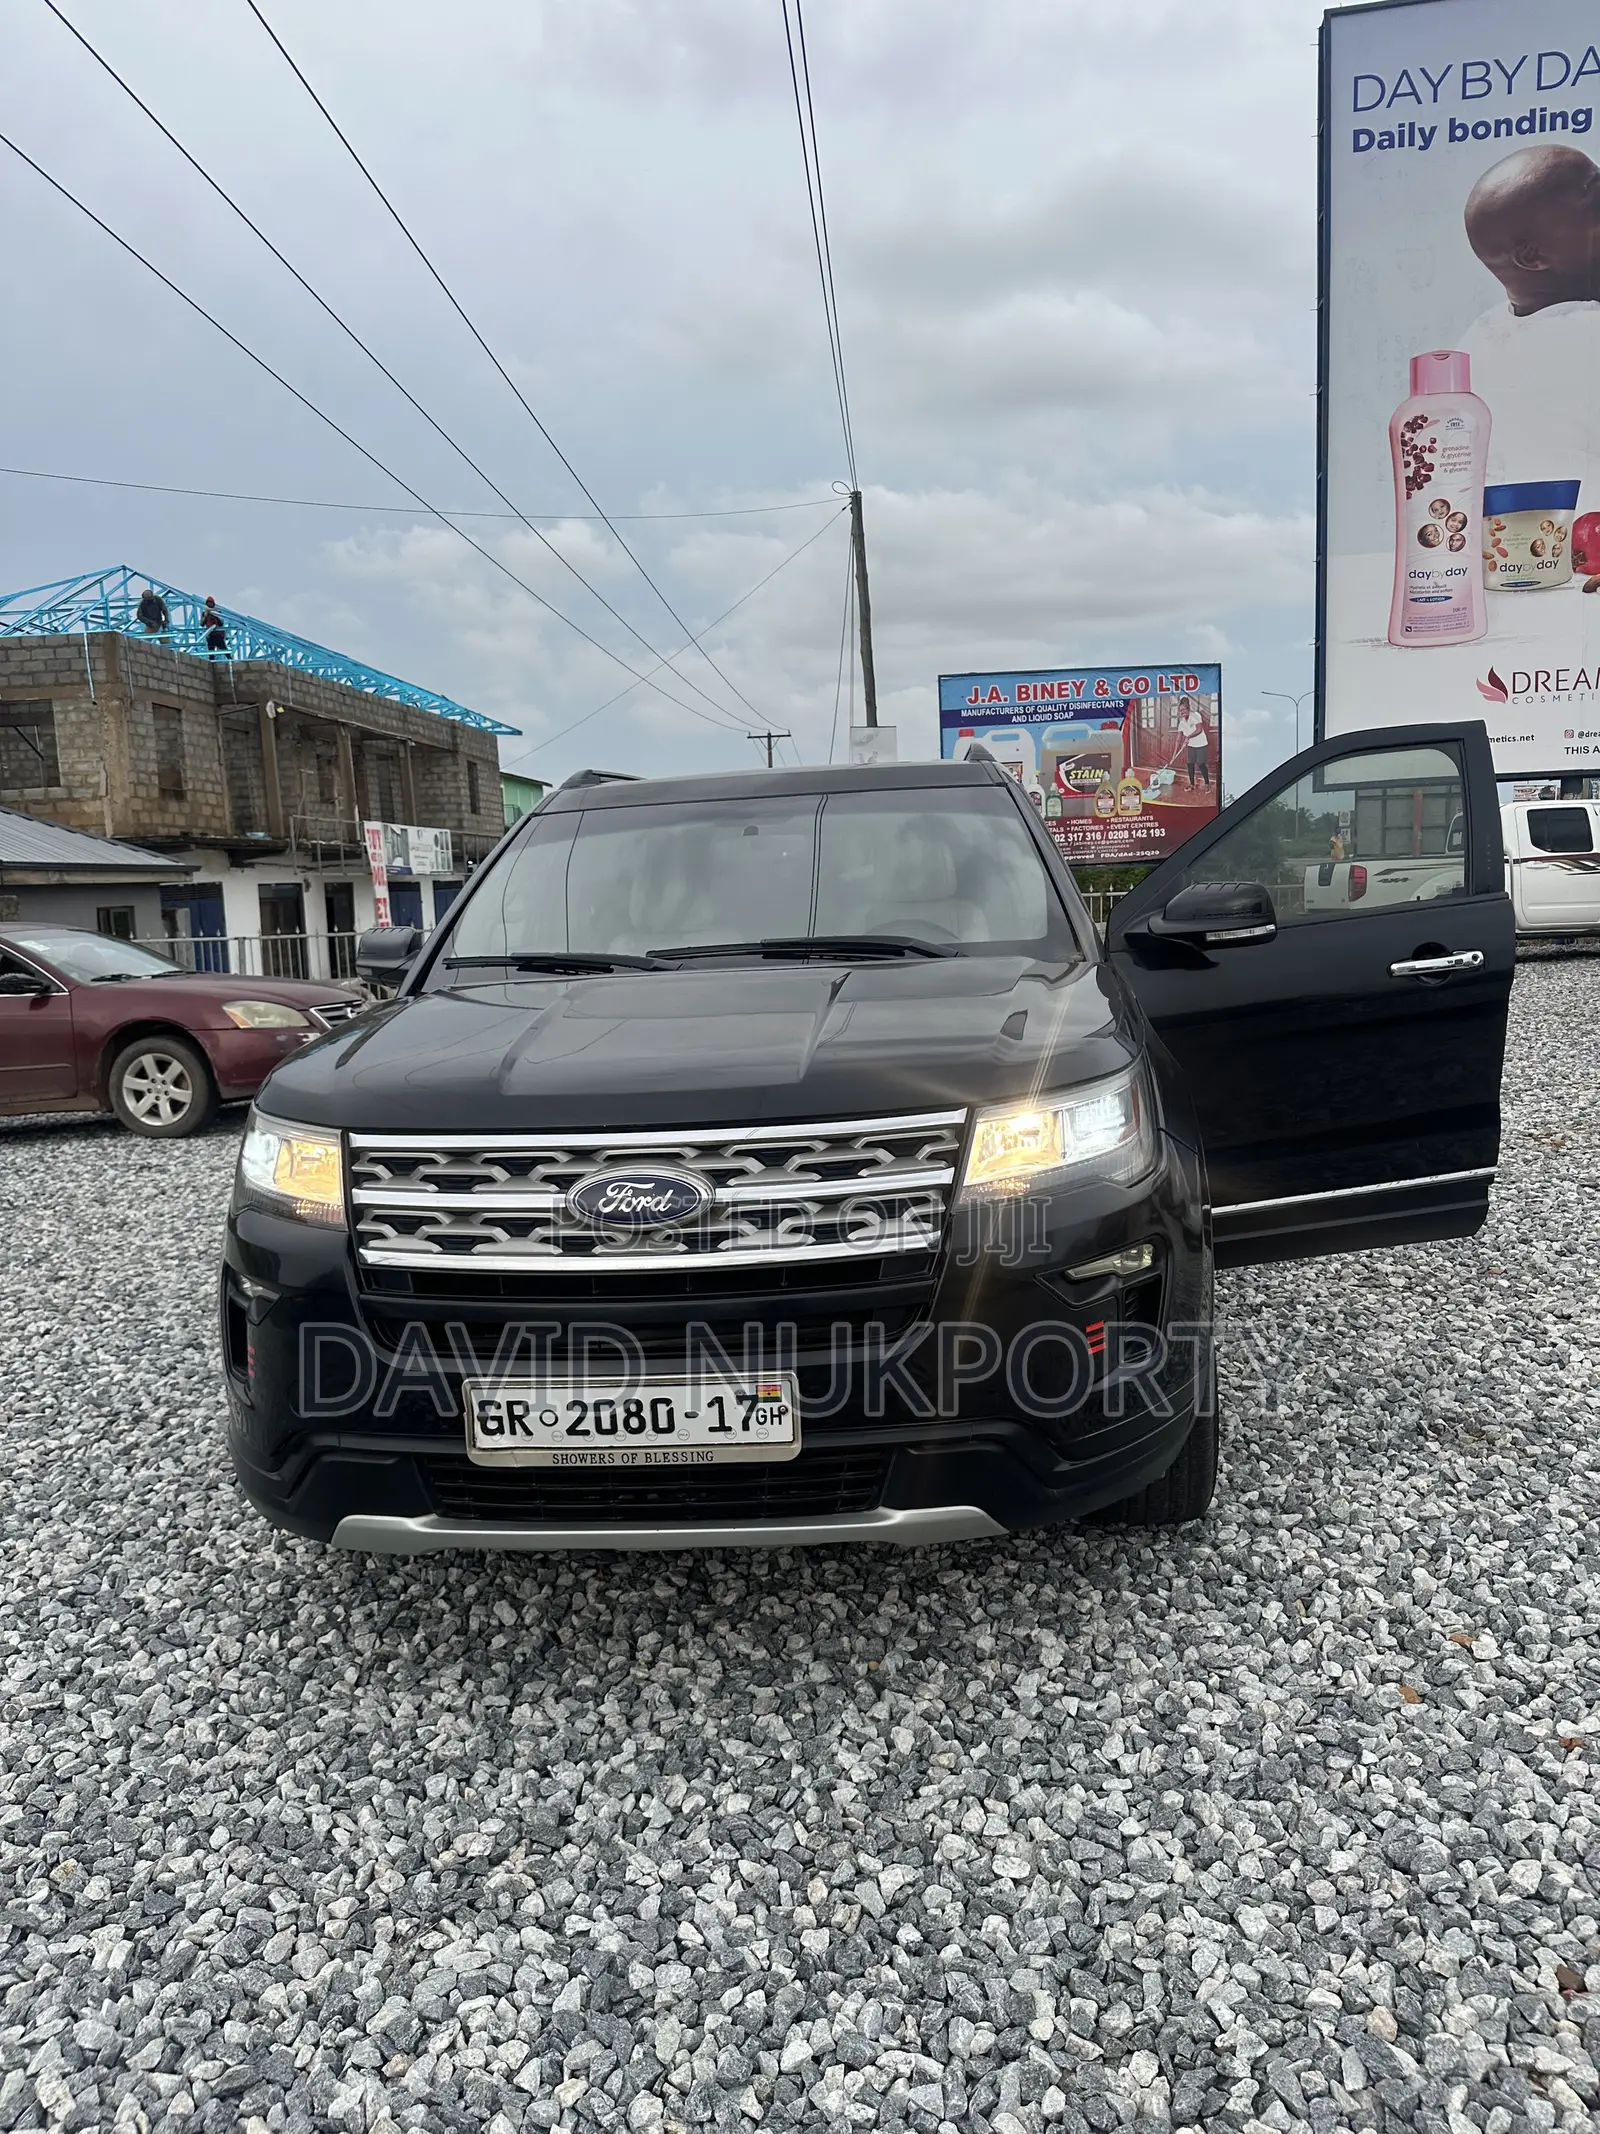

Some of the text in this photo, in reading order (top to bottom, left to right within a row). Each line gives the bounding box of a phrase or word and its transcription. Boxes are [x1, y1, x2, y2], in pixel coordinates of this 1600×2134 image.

[1353, 106, 1593, 153] Daily bonding
[1512, 667, 1600, 694] DREA
[967, 674, 1199, 705] J.A. BINEY & CO LTD
[961, 700, 1124, 718] MANUFACTURERS OF QUALITY DISINFECTANTS
[1011, 711, 1074, 723] AND LIQUID SOAP
[1564, 745, 1590, 755] THIS
[1069, 768, 1104, 780] STAIN
[1110, 815, 1154, 824] RESTAURANTS
[1131, 821, 1159, 829] CENTRES
[1067, 833, 1083, 841] 317
[1085, 832, 1101, 840] 316
[1102, 832, 1107, 840] /
[1108, 830, 1128, 840] 0208
[1131, 829, 1147, 838] 142
[1149, 828, 1166, 837] 193
[598, 1181, 676, 1213] Ford
[477, 1400, 534, 1437] GR
[755, 1407, 782, 1426] GH
[552, 1450, 714, 1465] SHOWERS OF BLESSING
